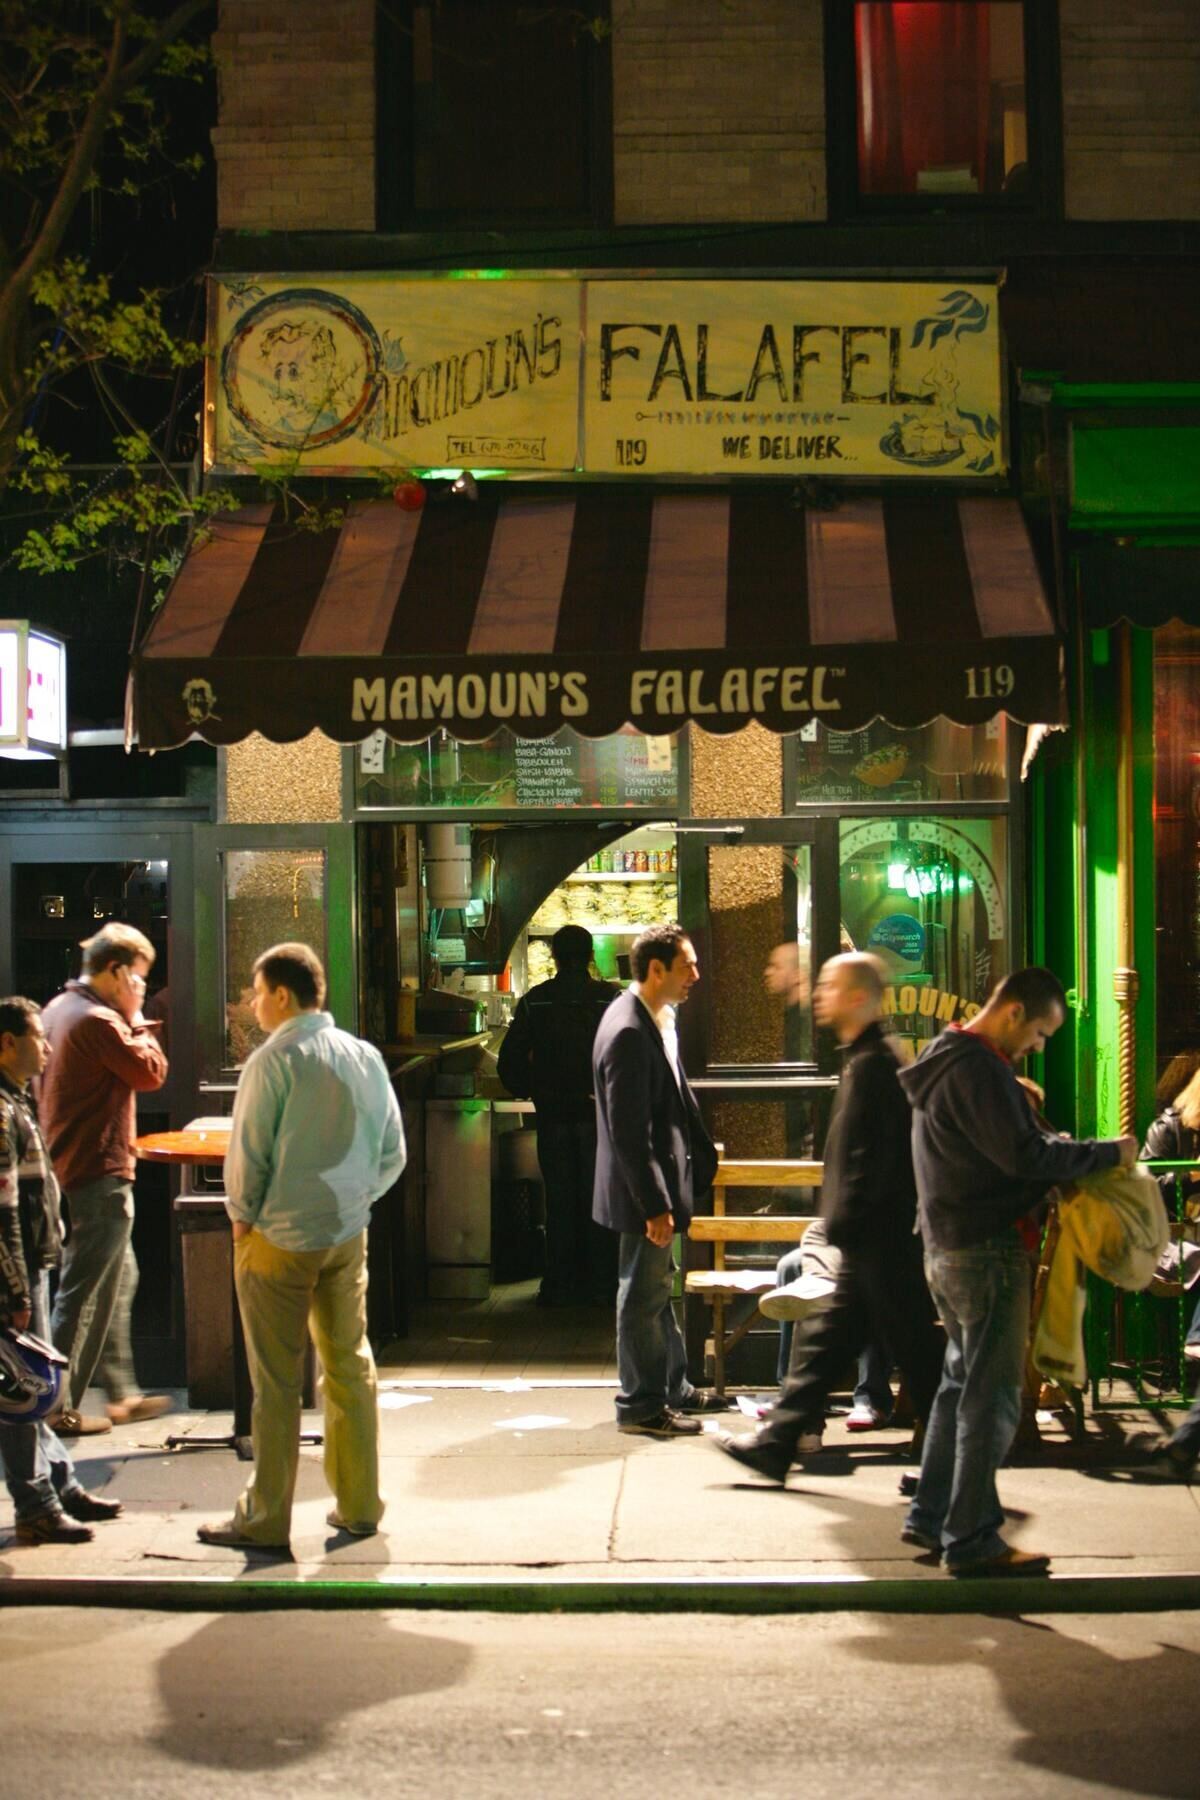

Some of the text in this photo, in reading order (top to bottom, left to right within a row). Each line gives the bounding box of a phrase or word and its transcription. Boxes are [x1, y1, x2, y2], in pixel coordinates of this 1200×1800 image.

[600, 323, 935, 405] FALAFEL
[615, 439, 647, 467] 119
[722, 435, 751, 459] WE
[351, 671, 589, 723] MAMOUN'S
[965, 665, 1015, 700] 119
[624, 786, 656, 797] LENTIL
